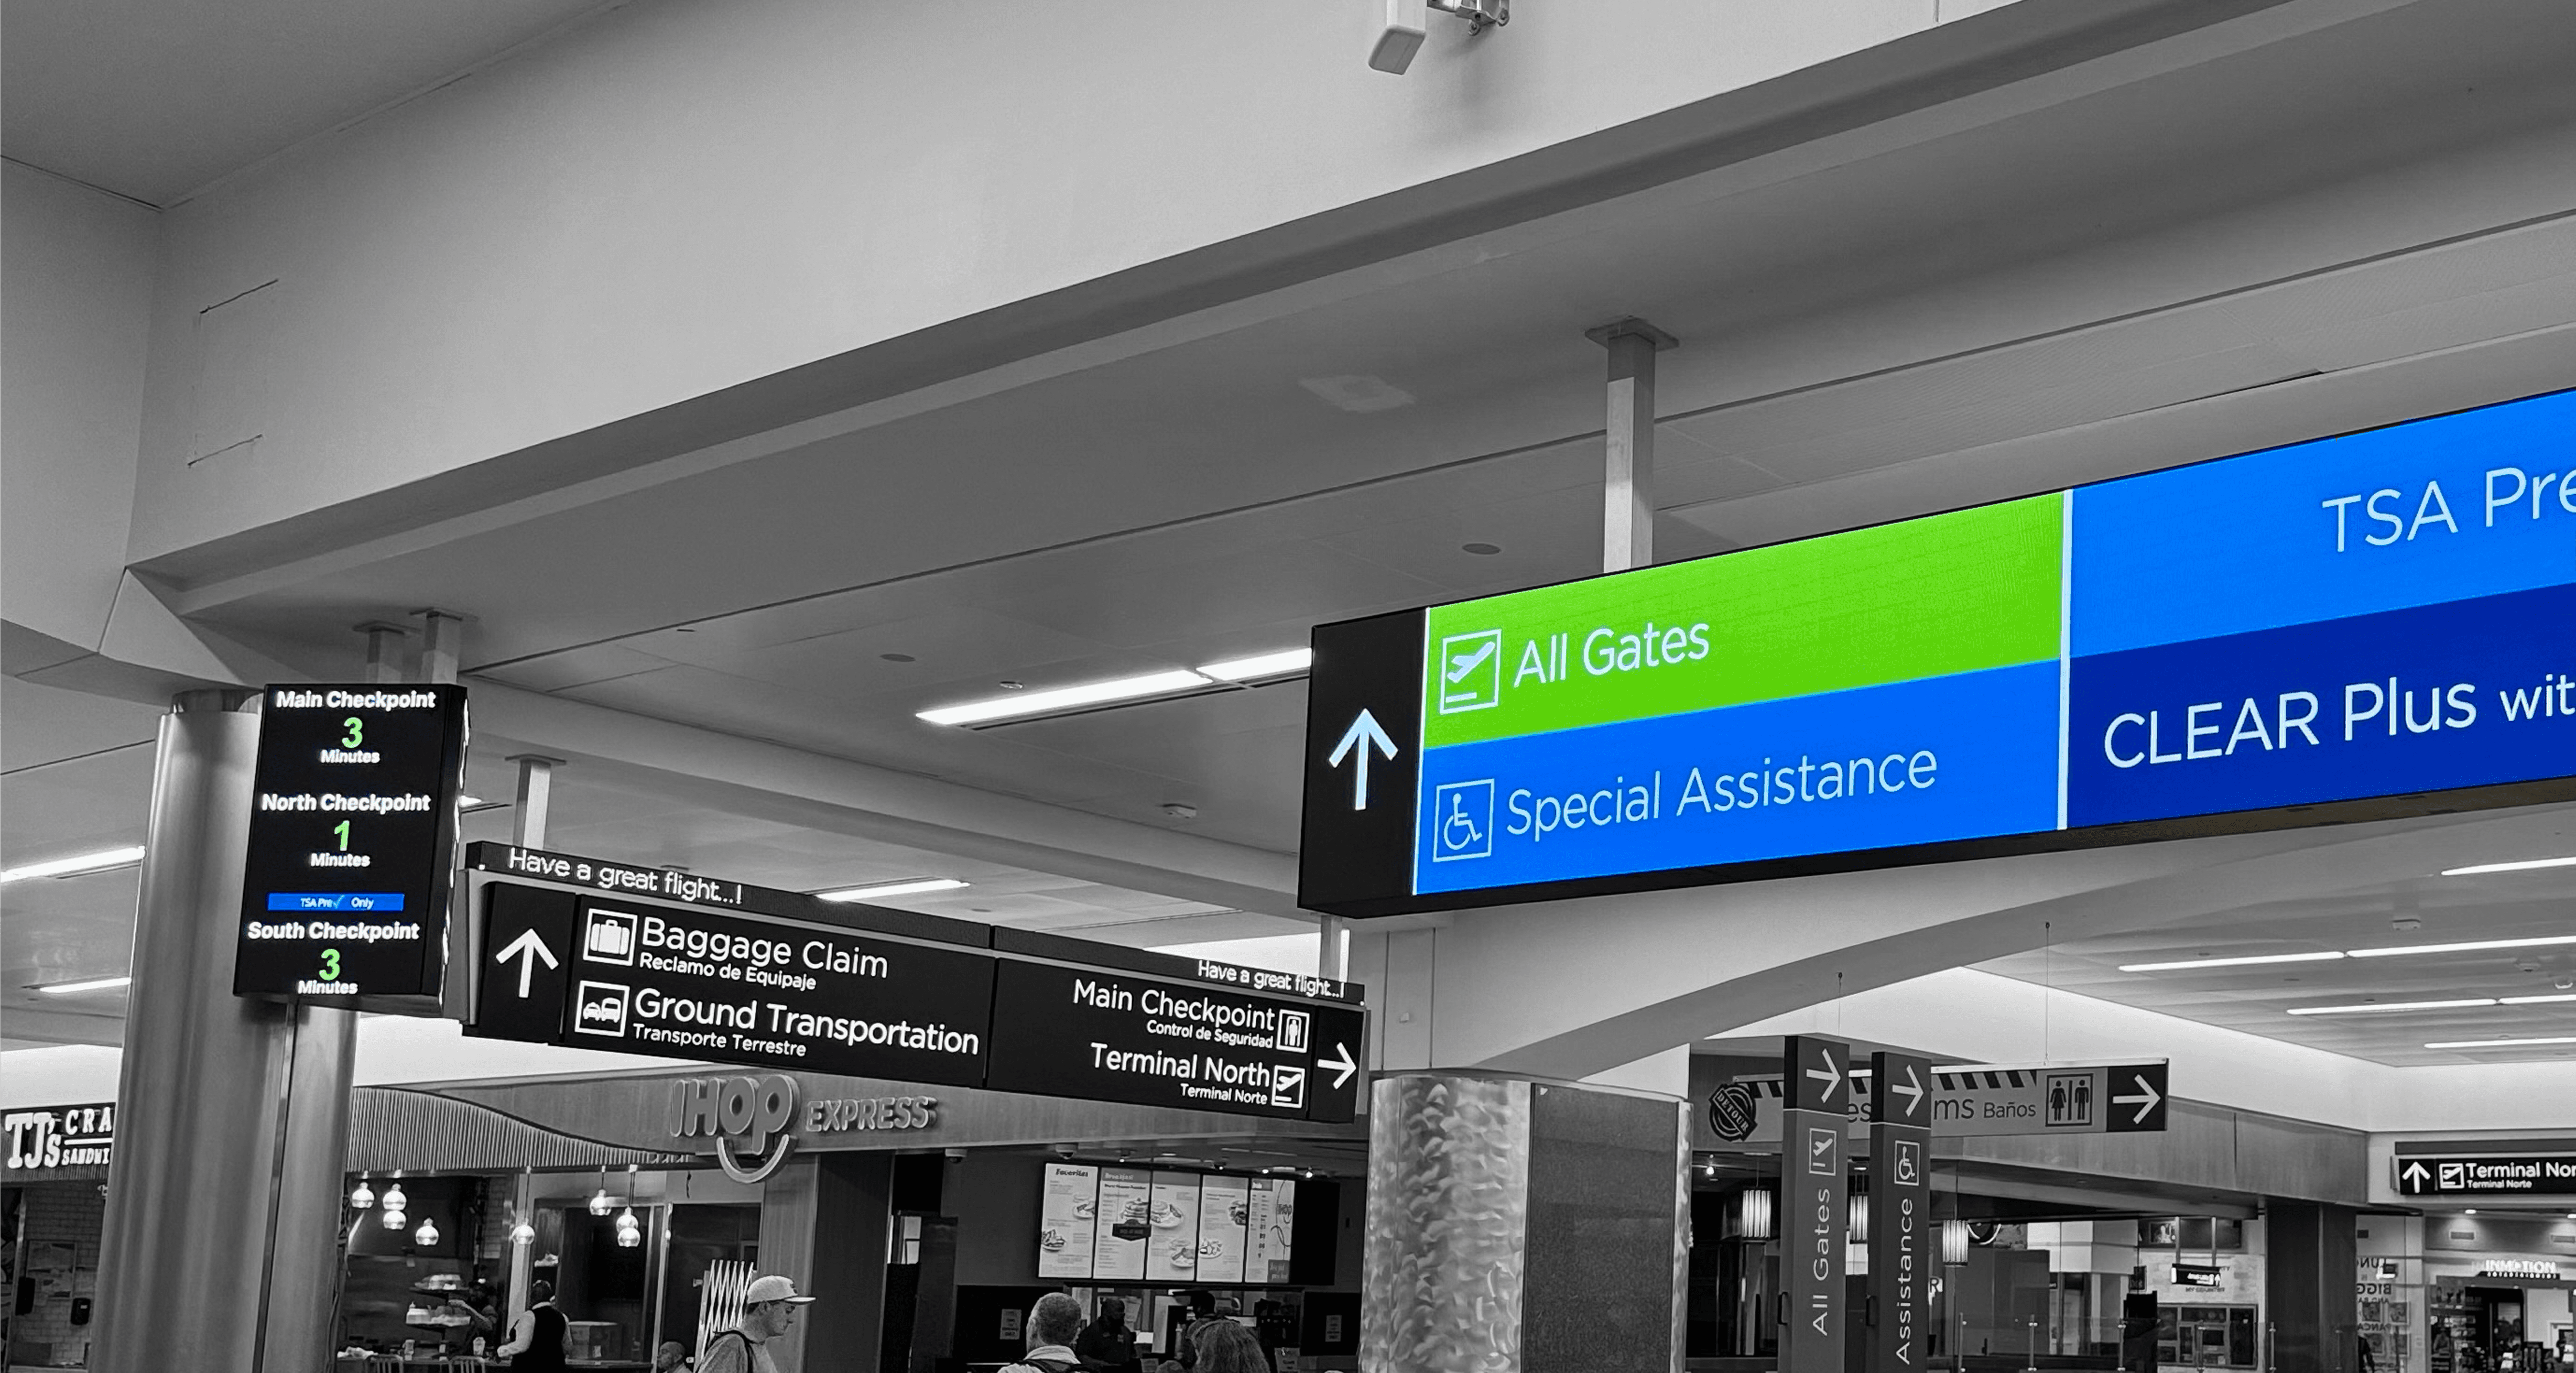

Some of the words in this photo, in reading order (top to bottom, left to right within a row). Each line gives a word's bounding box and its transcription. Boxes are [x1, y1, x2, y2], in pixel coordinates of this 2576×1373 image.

[2322, 481, 2458, 552] TSA
[2485, 467, 2576, 527] Pre
[1513, 633, 1568, 688] All
[1583, 622, 1710, 676] Gates
[276, 690, 323, 708] Main
[326, 690, 437, 711] Checkpoint
[341, 717, 363, 748] 3
[2104, 691, 2320, 768] CLEAR
[2344, 677, 2477, 741] Plus
[2499, 673, 2576, 721] wit
[320, 749, 380, 764] Minutes
[260, 793, 317, 811] North
[320, 793, 431, 814] Checkpoint
[1506, 771, 1660, 842] Special
[1677, 750, 1937, 816] Assistance
[334, 820, 350, 851] 1
[310, 853, 371, 867] Minutes
[509, 847, 570, 877] Have
[577, 863, 591, 881] a
[599, 866, 658, 889] great
[665, 871, 742, 905] flight...!
[300, 897, 317, 907] TSA
[351, 897, 374, 910] Only
[247, 921, 305, 939] South
[308, 921, 420, 943] Checkpoint
[642, 917, 792, 966] Baggage
[802, 941, 888, 978] Claim
[319, 949, 341, 981] 3
[639, 952, 715, 977] Reclamo
[719, 964, 741, 980] de
[745, 966, 817, 991] Equipaje
[1198, 960, 1237, 982] Have
[1240, 969, 1250, 984] a
[1254, 972, 1292, 990] great
[1295, 974, 1345, 999] flight...!
[297, 980, 358, 994] Minutes
[1073, 978, 1133, 1011] Main
[1141, 989, 1275, 1031] Checkpoint
[635, 988, 757, 1029] Ground
[766, 1003, 979, 1055] Transportation
[1147, 1019, 1192, 1039] Control
[1195, 1026, 1212, 1041] de
[1214, 1028, 1274, 1049] Seguridad
[633, 1023, 727, 1048] Transporte
[732, 1033, 807, 1057] Terrestre
[1091, 1042, 1198, 1080] Terminal
[1205, 1056, 1270, 1087] North
[1180, 1083, 1232, 1101] Terminal
[1234, 1088, 1268, 1105] Norte
[1983, 1101, 2037, 1119] Baños
[806, 1096, 935, 1133] EXPRESS
[1717, 1093, 1749, 1132] DETOUR
[2465, 1161, 2541, 1179] Terminal
[2546, 1161, 2576, 1178] Nor
[2466, 1180, 2505, 1189] Terminal
[2506, 1180, 2532, 1189] Norte
[1812, 1187, 1831, 1281] Gates
[1895, 1197, 1914, 1366] Assistance
[1812, 1293, 1829, 1336] All
